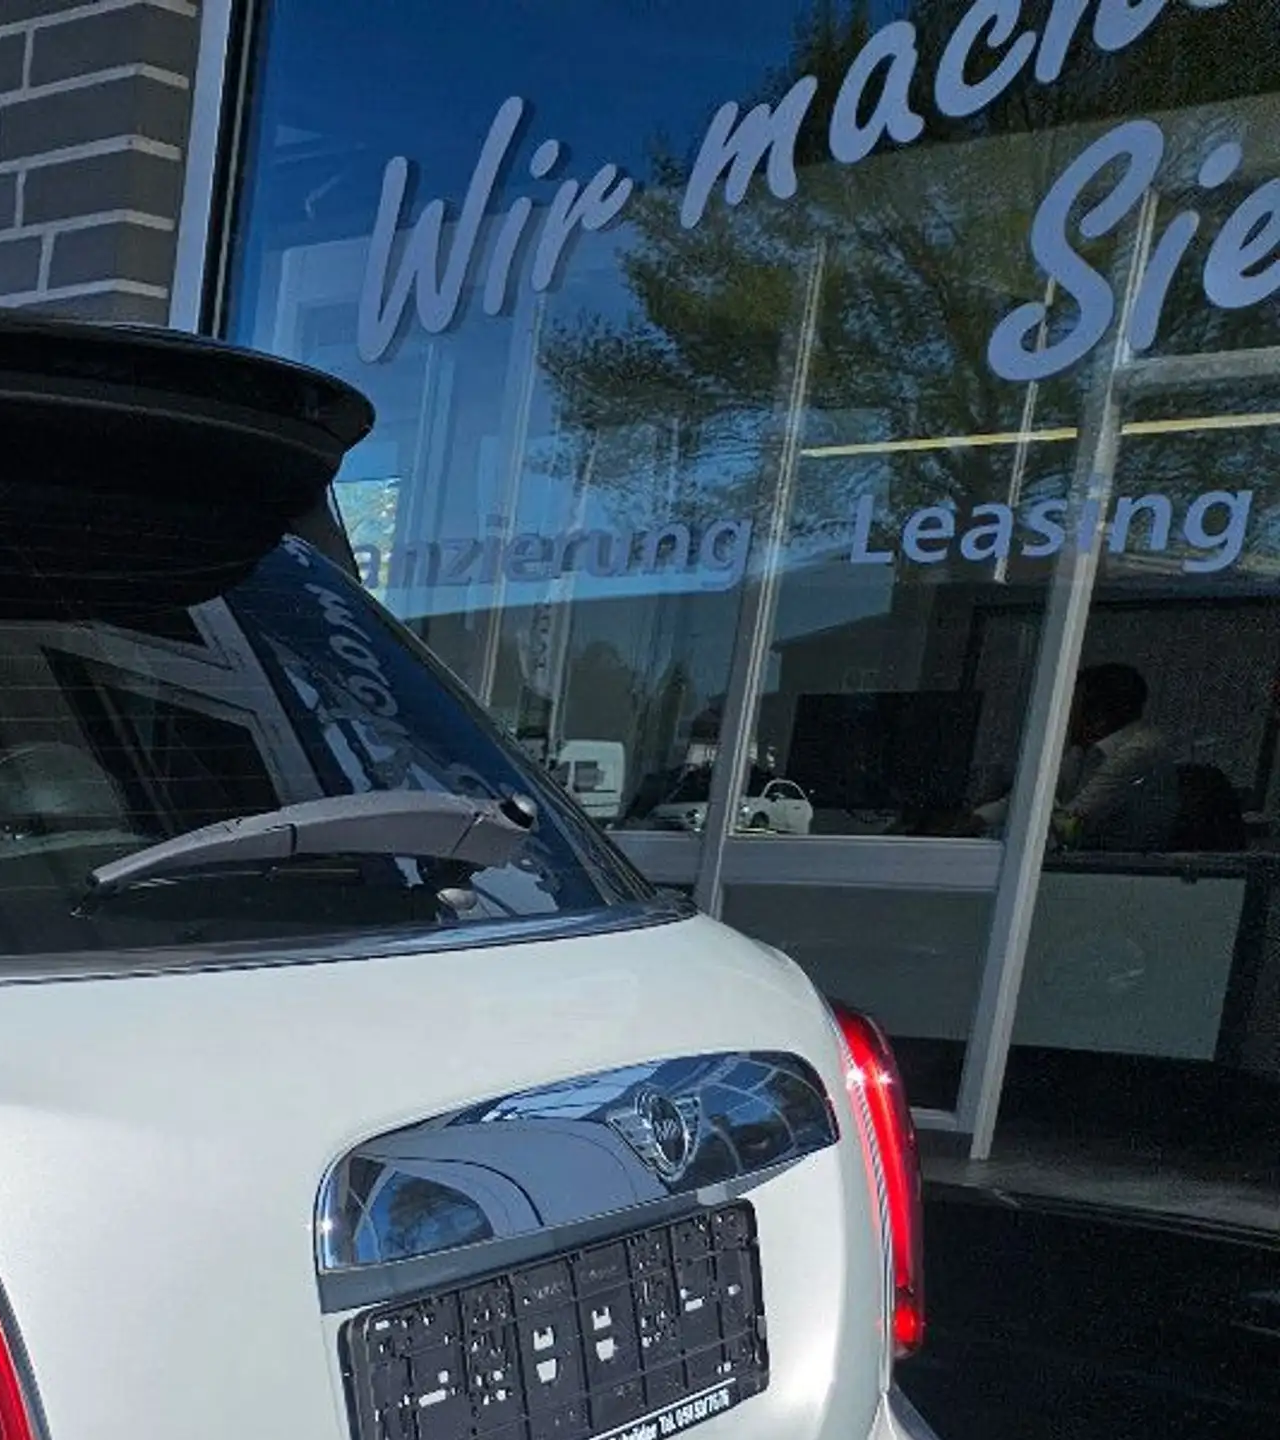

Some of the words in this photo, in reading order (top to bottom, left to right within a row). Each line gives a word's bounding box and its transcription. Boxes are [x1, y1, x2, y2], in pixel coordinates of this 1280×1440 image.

[357, 95, 633, 363] Wir
[987, 119, 1280, 381] Sie
[850, 472, 1253, 573] Leasing
